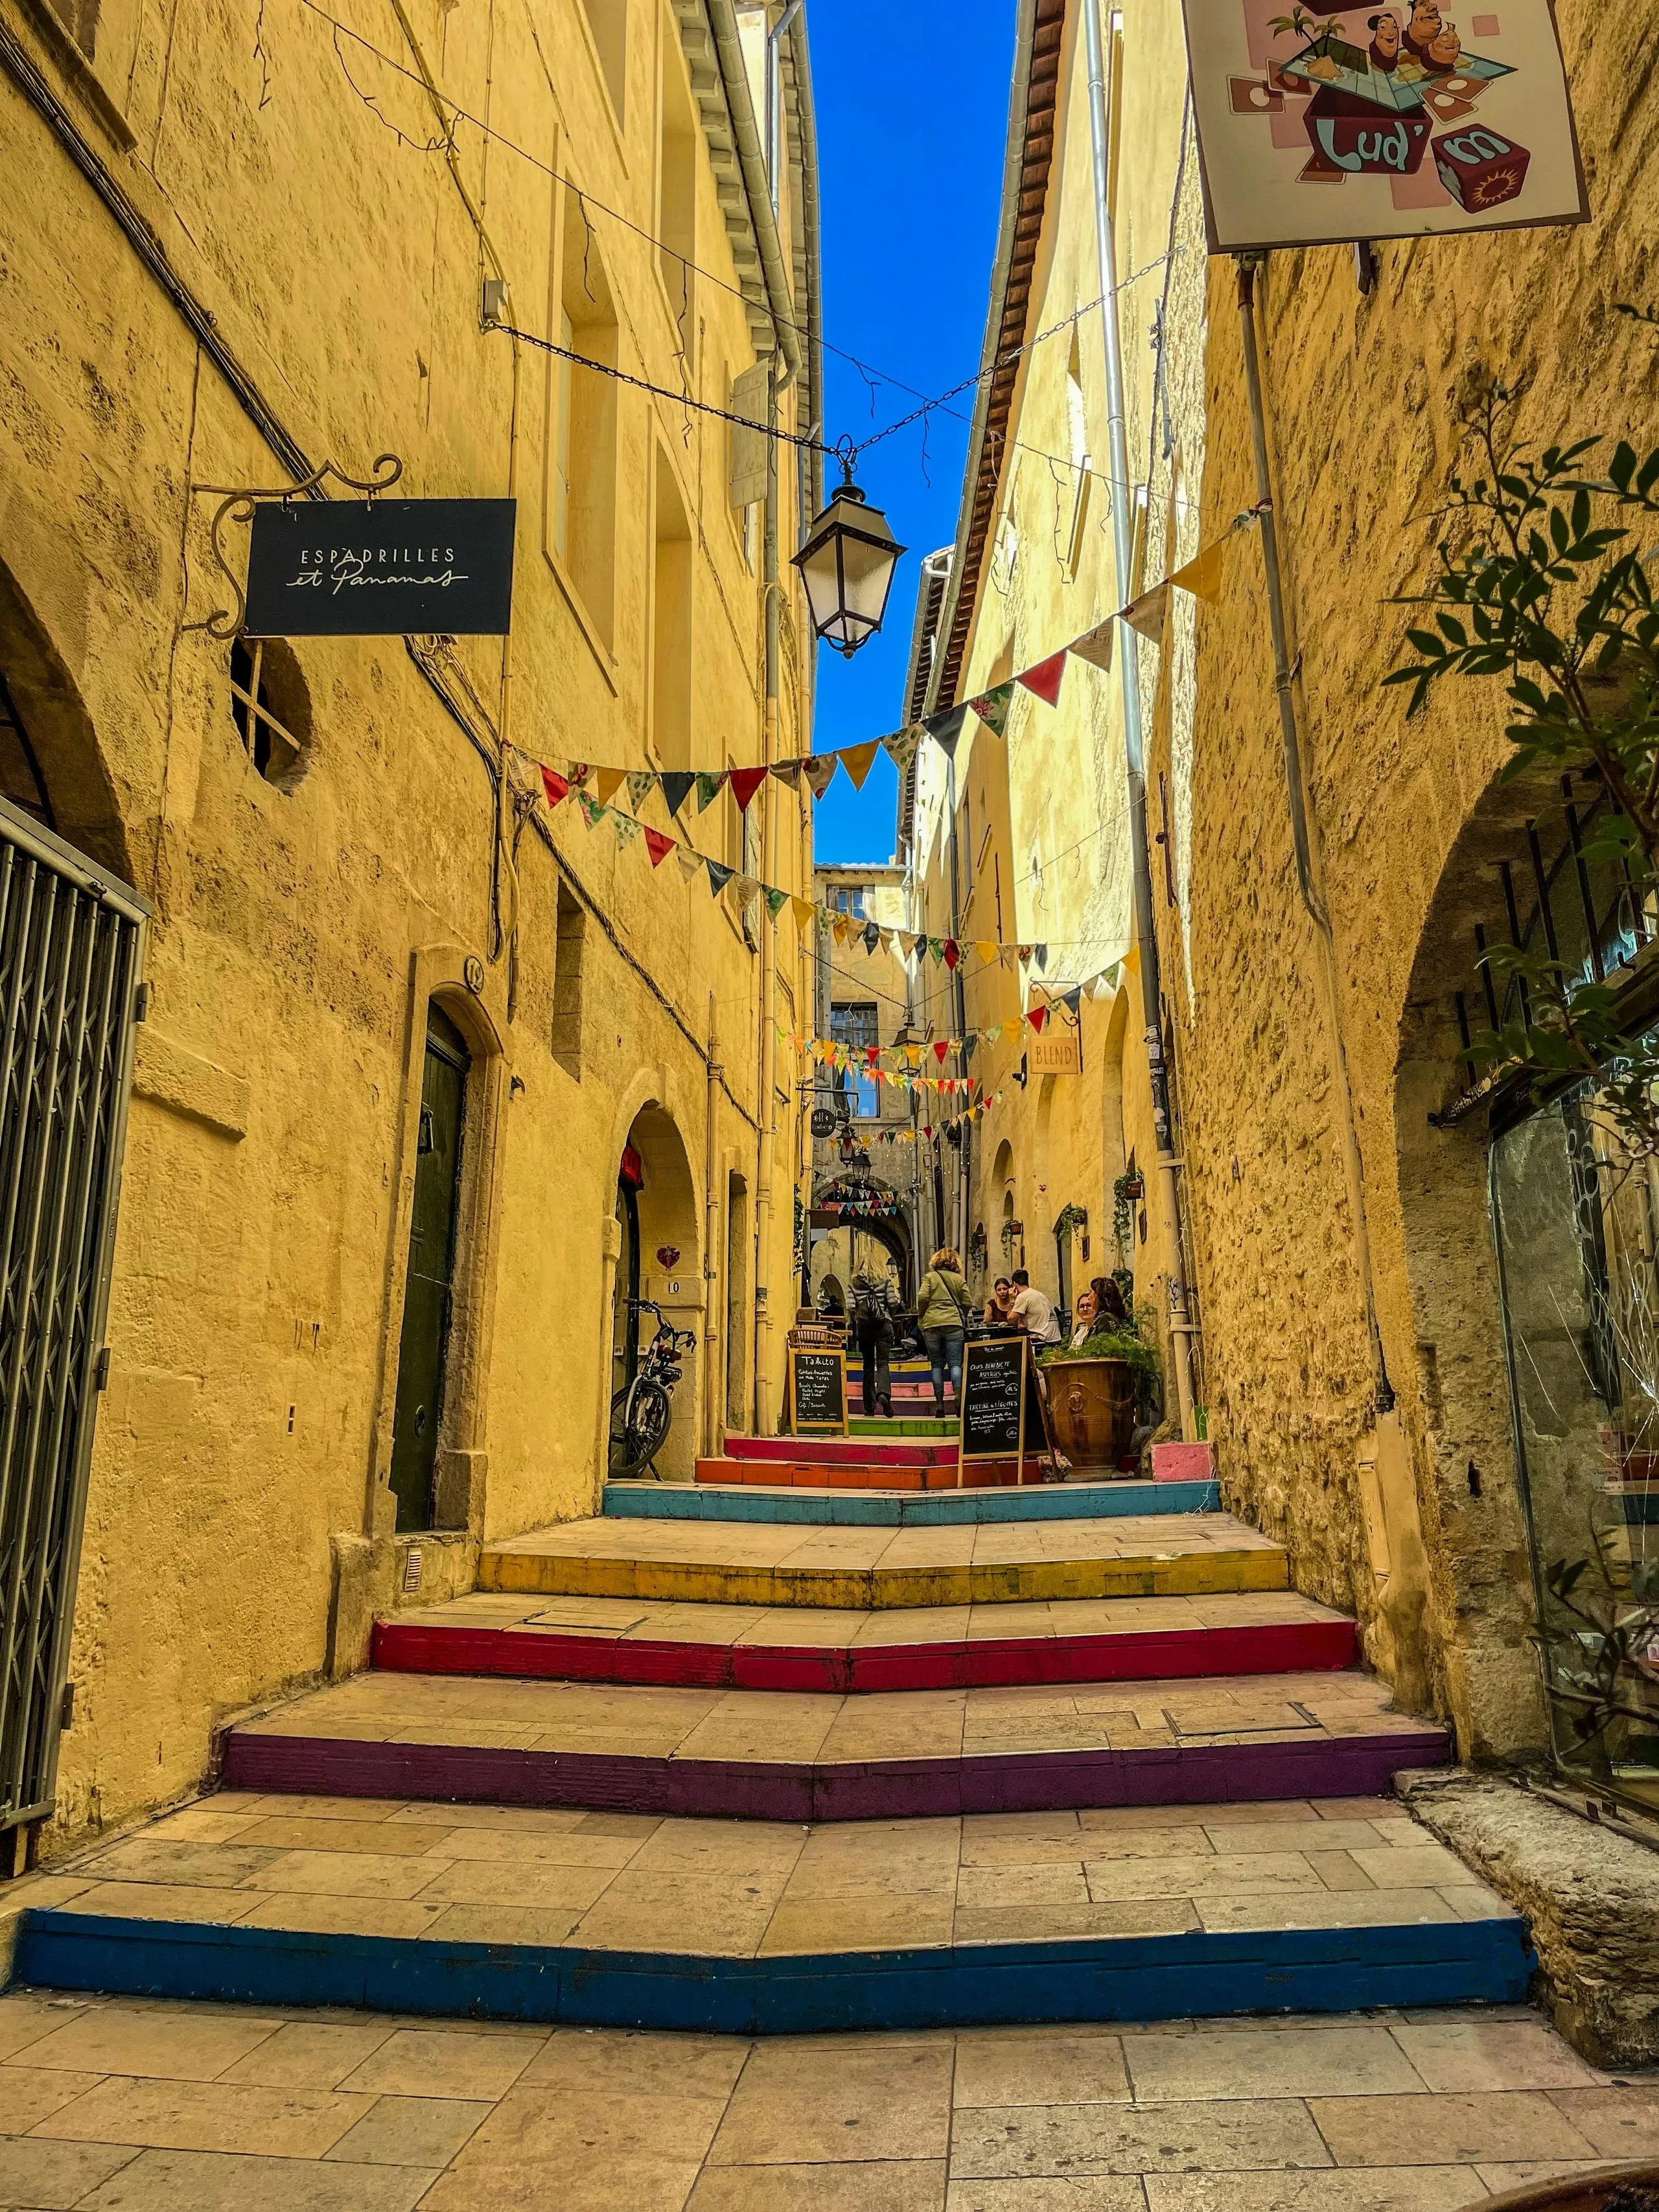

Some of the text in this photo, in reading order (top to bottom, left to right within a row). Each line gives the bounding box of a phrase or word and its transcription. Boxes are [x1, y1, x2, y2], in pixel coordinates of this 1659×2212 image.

[286, 559, 469, 595] et Panamas
[1035, 1045, 1072, 1065] BLEND
[668, 1282, 679, 1292] 10
[801, 1356, 834, 1366] Takito
